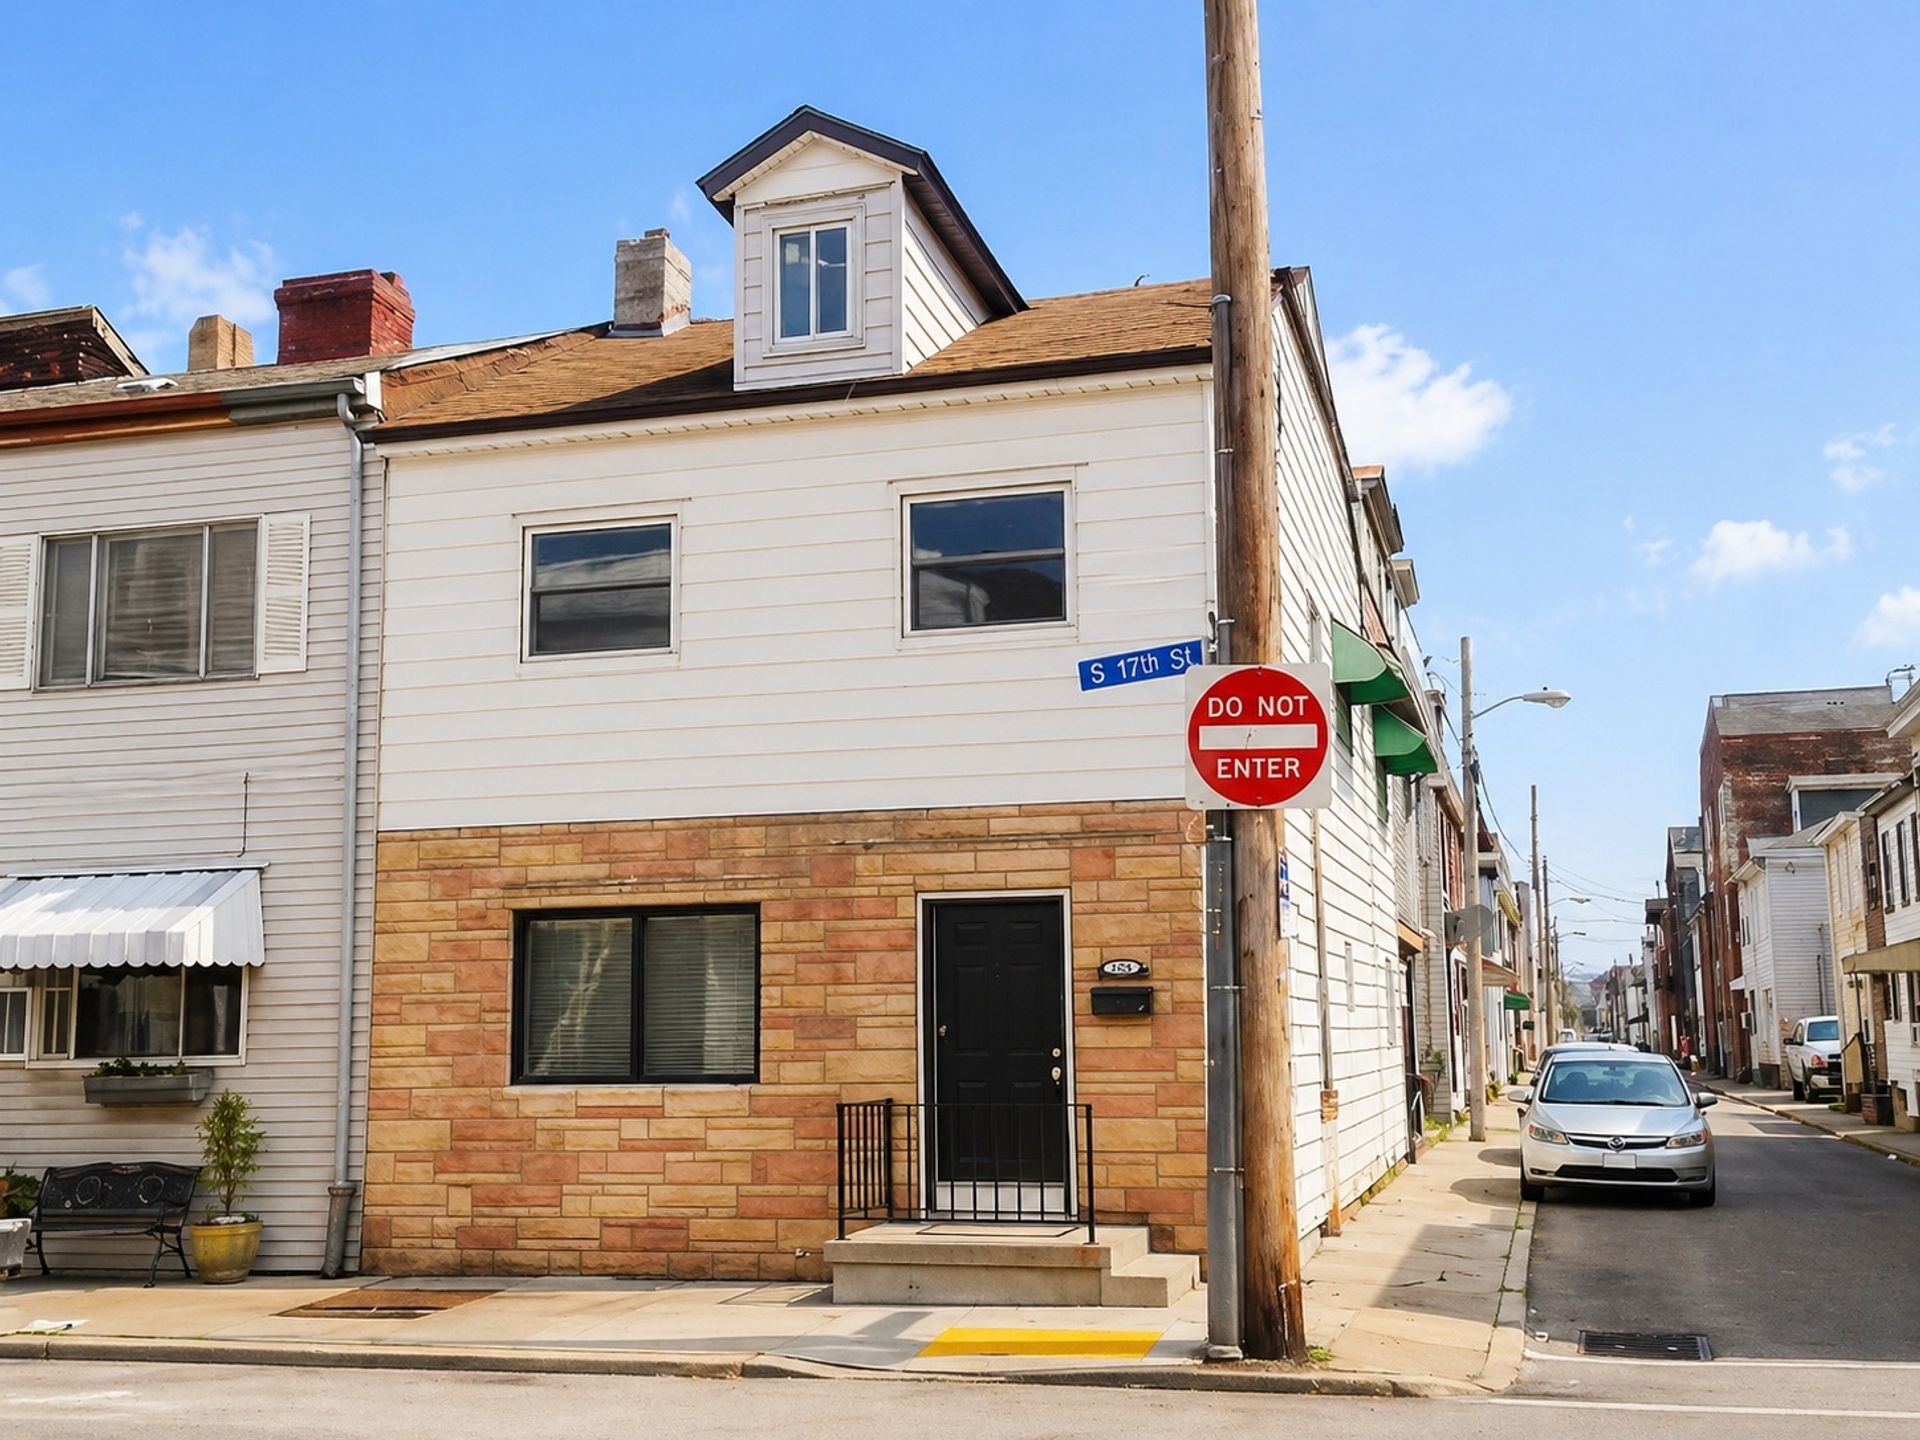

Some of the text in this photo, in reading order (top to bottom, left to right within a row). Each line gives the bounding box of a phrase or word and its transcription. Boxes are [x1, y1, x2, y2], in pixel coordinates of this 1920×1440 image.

[1090, 663, 1105, 684] S
[1116, 654, 1159, 680] 17th
[1207, 696, 1309, 718] DO NOT
[1217, 757, 1300, 779] ENTER
